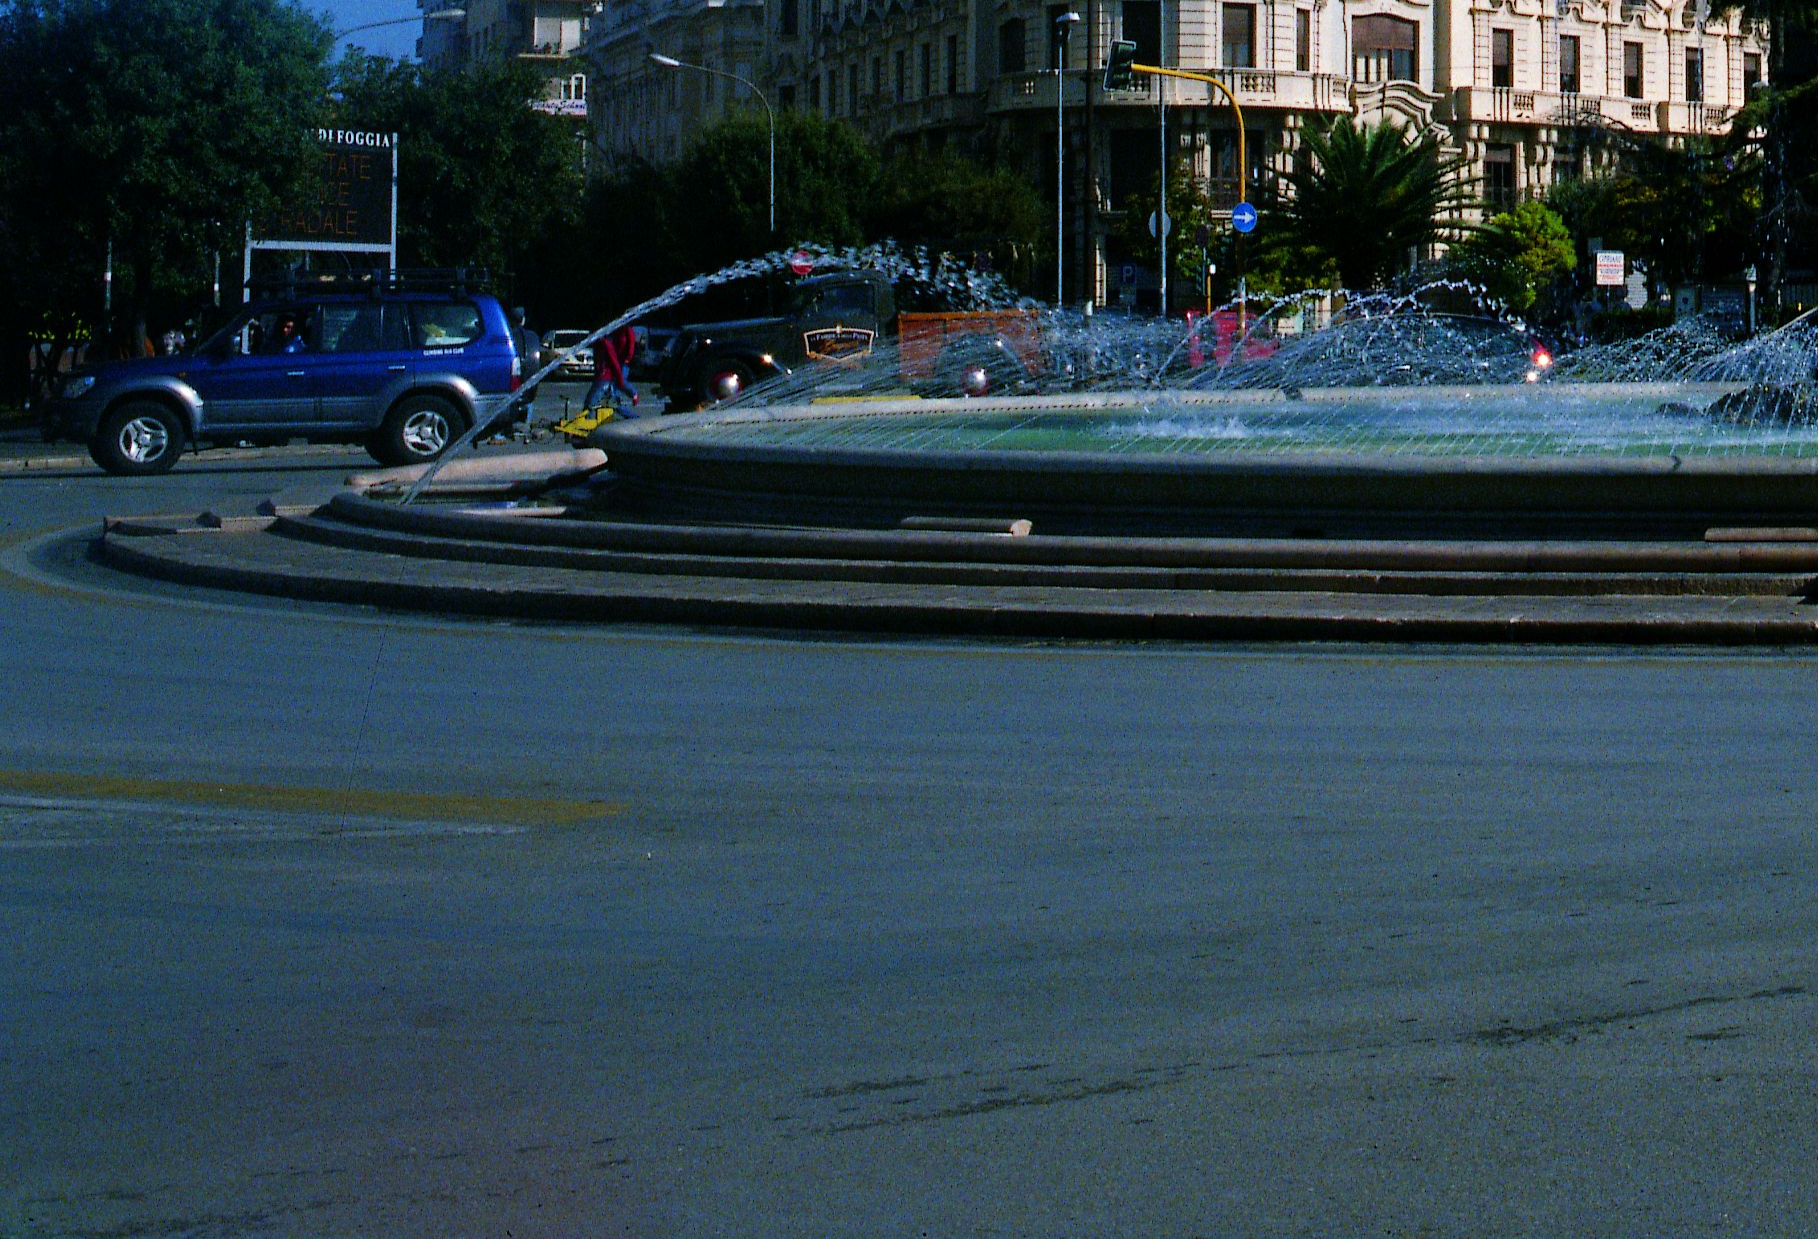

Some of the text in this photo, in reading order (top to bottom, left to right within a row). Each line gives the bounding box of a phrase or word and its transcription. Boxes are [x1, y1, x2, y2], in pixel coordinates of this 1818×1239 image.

[318, 128, 333, 143] DI
[337, 130, 390, 148] FOGGIA
[1122, 265, 1134, 283] P
